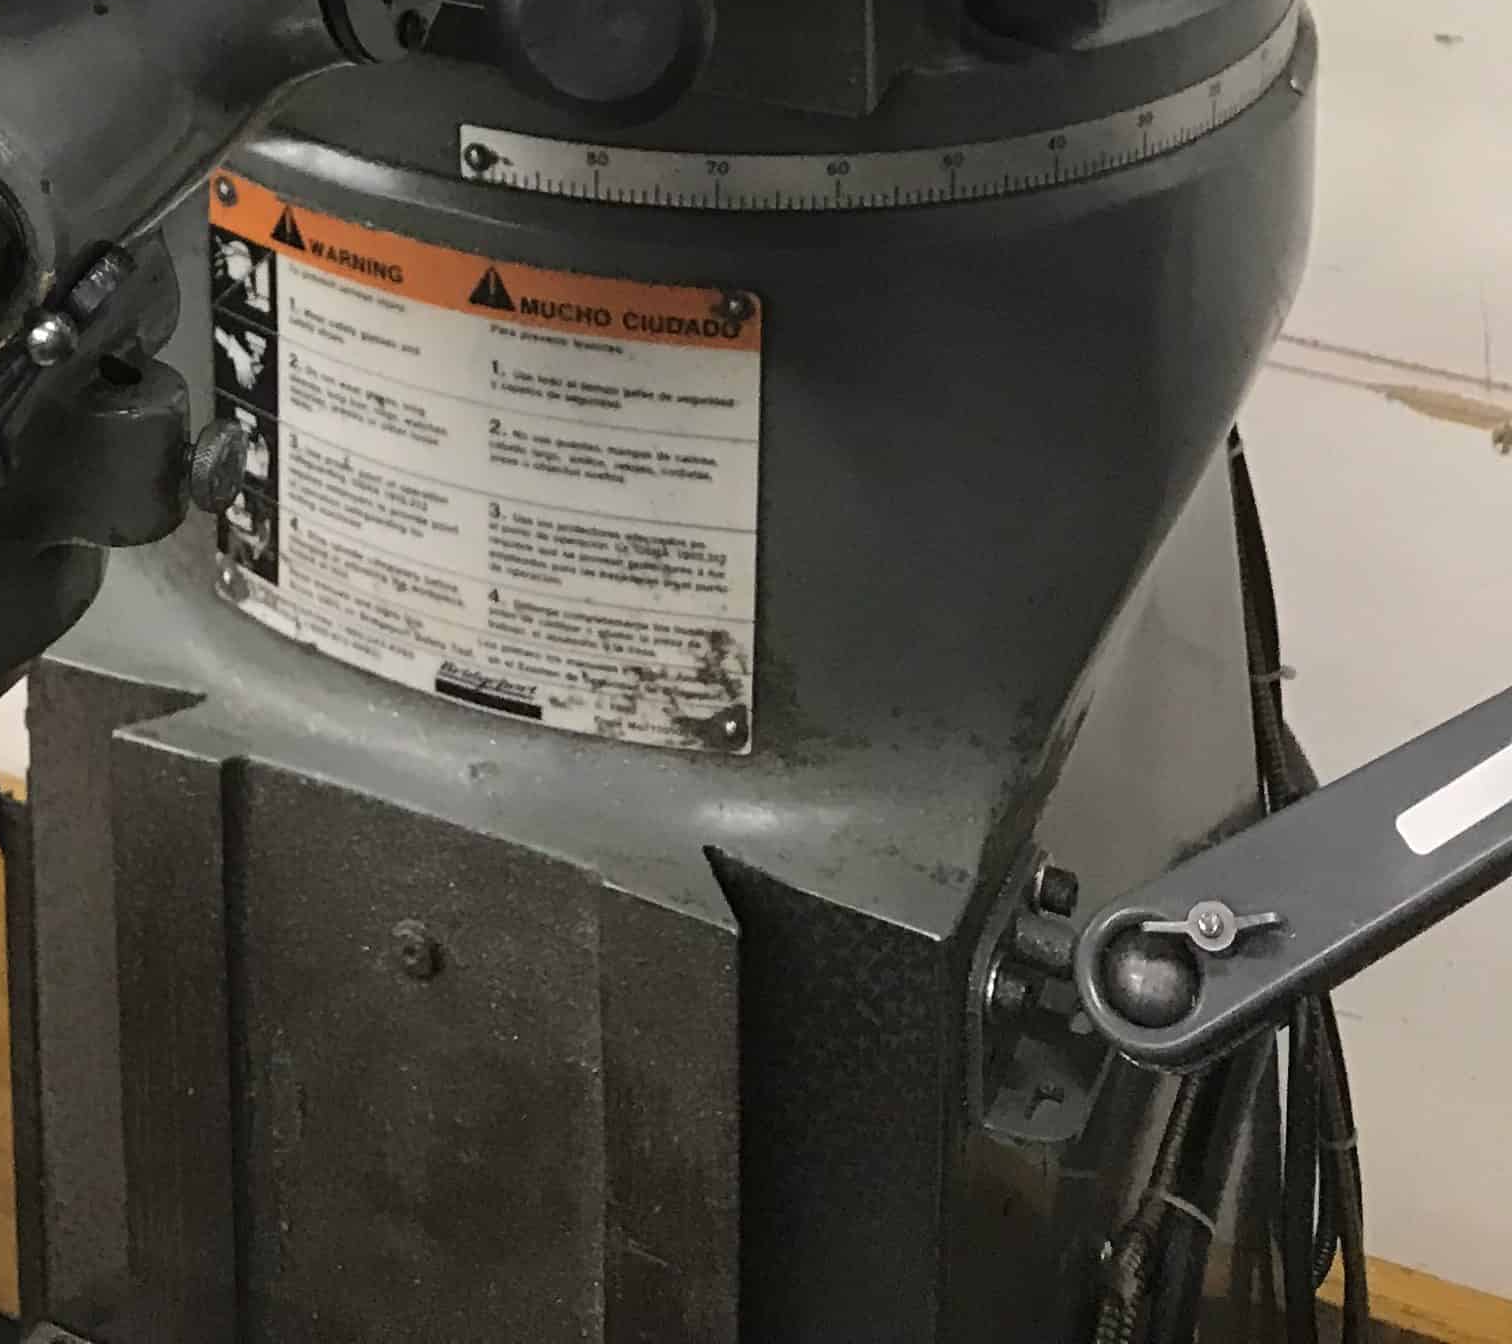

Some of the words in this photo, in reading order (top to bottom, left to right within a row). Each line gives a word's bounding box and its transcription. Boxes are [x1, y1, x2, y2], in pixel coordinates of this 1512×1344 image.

[705, 159, 730, 177] 70
[825, 160, 851, 177] 60
[309, 239, 404, 285] WARNING
[519, 296, 612, 328] MUCHO
